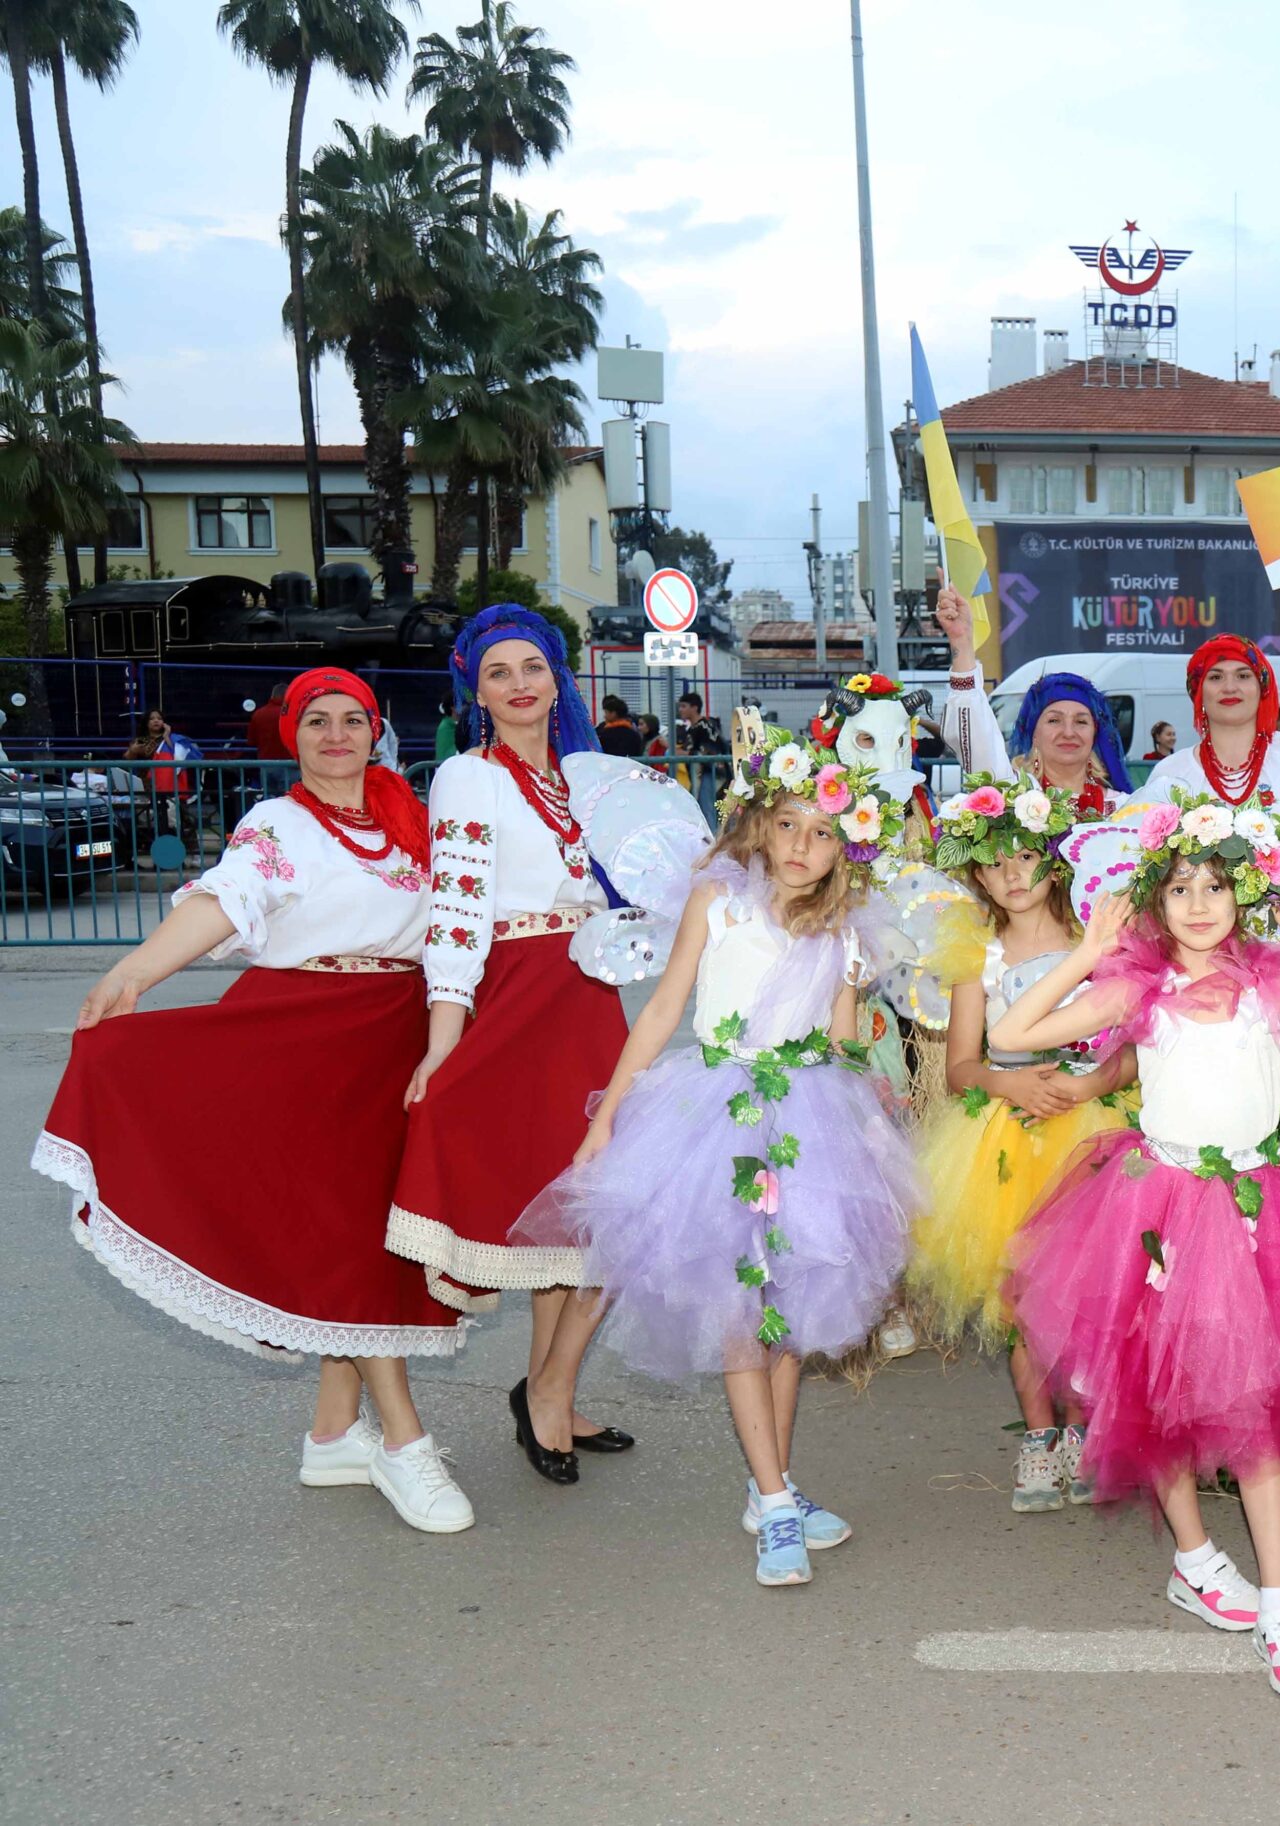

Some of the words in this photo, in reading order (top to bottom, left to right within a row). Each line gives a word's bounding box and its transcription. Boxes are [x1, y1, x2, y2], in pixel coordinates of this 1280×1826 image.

[1088, 302, 1177, 329] TCDD
[1048, 539, 1072, 550] T.C.
[1074, 536, 1123, 550] KÜLTÜR
[1126, 539, 1143, 550] VE
[1146, 536, 1195, 550] TURİZM
[1110, 573, 1179, 590] TÜRKİYE
[1072, 595, 1154, 630] KÜLTÜR
[1155, 596, 1216, 629] YOLU
[1106, 630, 1185, 646] FESTİVALİ
